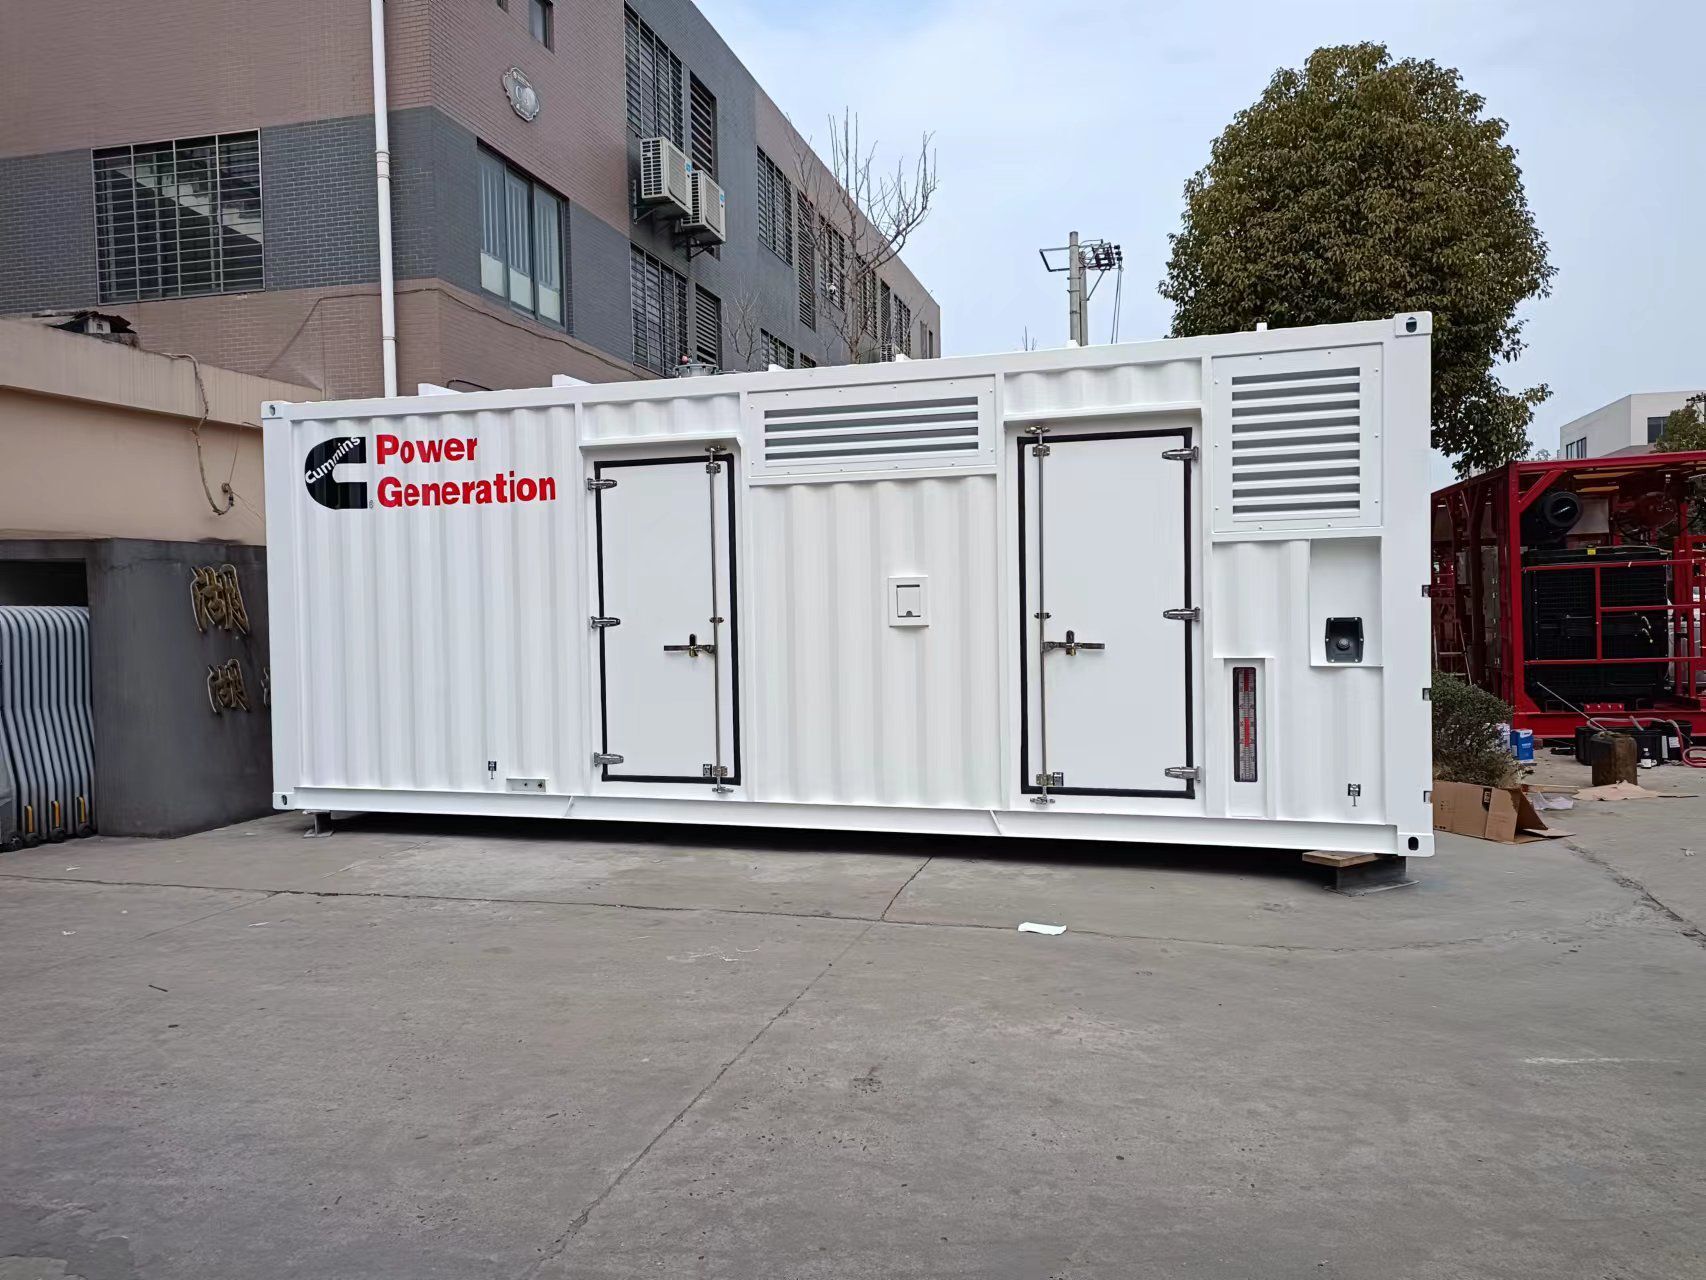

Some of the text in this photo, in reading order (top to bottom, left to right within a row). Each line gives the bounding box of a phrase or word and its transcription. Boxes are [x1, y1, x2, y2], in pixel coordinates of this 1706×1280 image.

[305, 436, 361, 484] Cummins
[376, 434, 478, 465] Power
[377, 471, 556, 507] Generation
